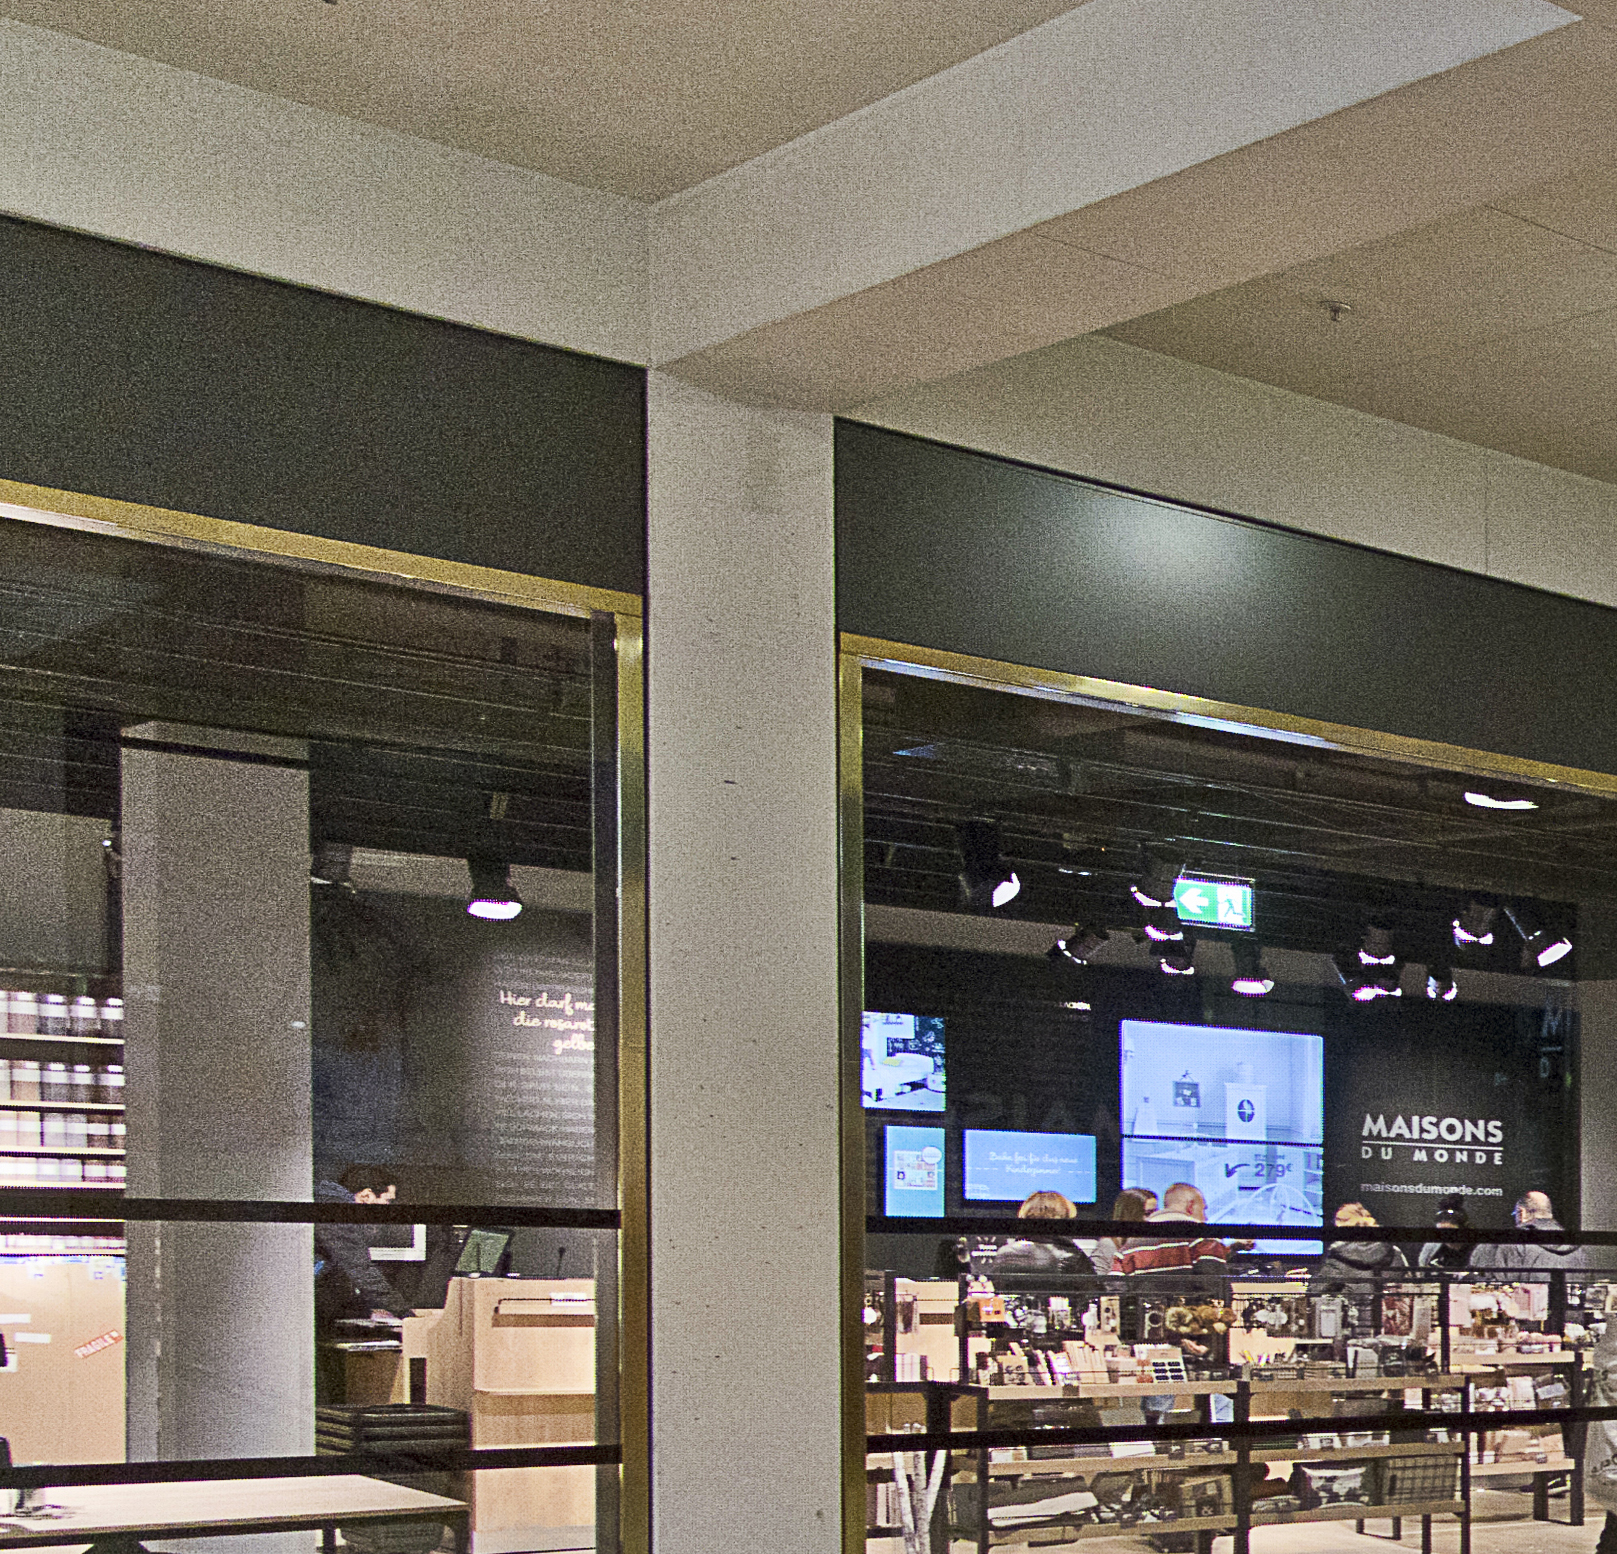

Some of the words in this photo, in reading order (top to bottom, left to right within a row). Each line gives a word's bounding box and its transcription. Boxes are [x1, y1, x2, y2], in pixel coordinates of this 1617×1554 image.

[1362, 1113, 1503, 1143] MAISONS
[1361, 1146, 1393, 1160] DU
[1412, 1149, 1503, 1165] MONDE
[1360, 1182, 1503, 1197] maisonsdumonde.com
